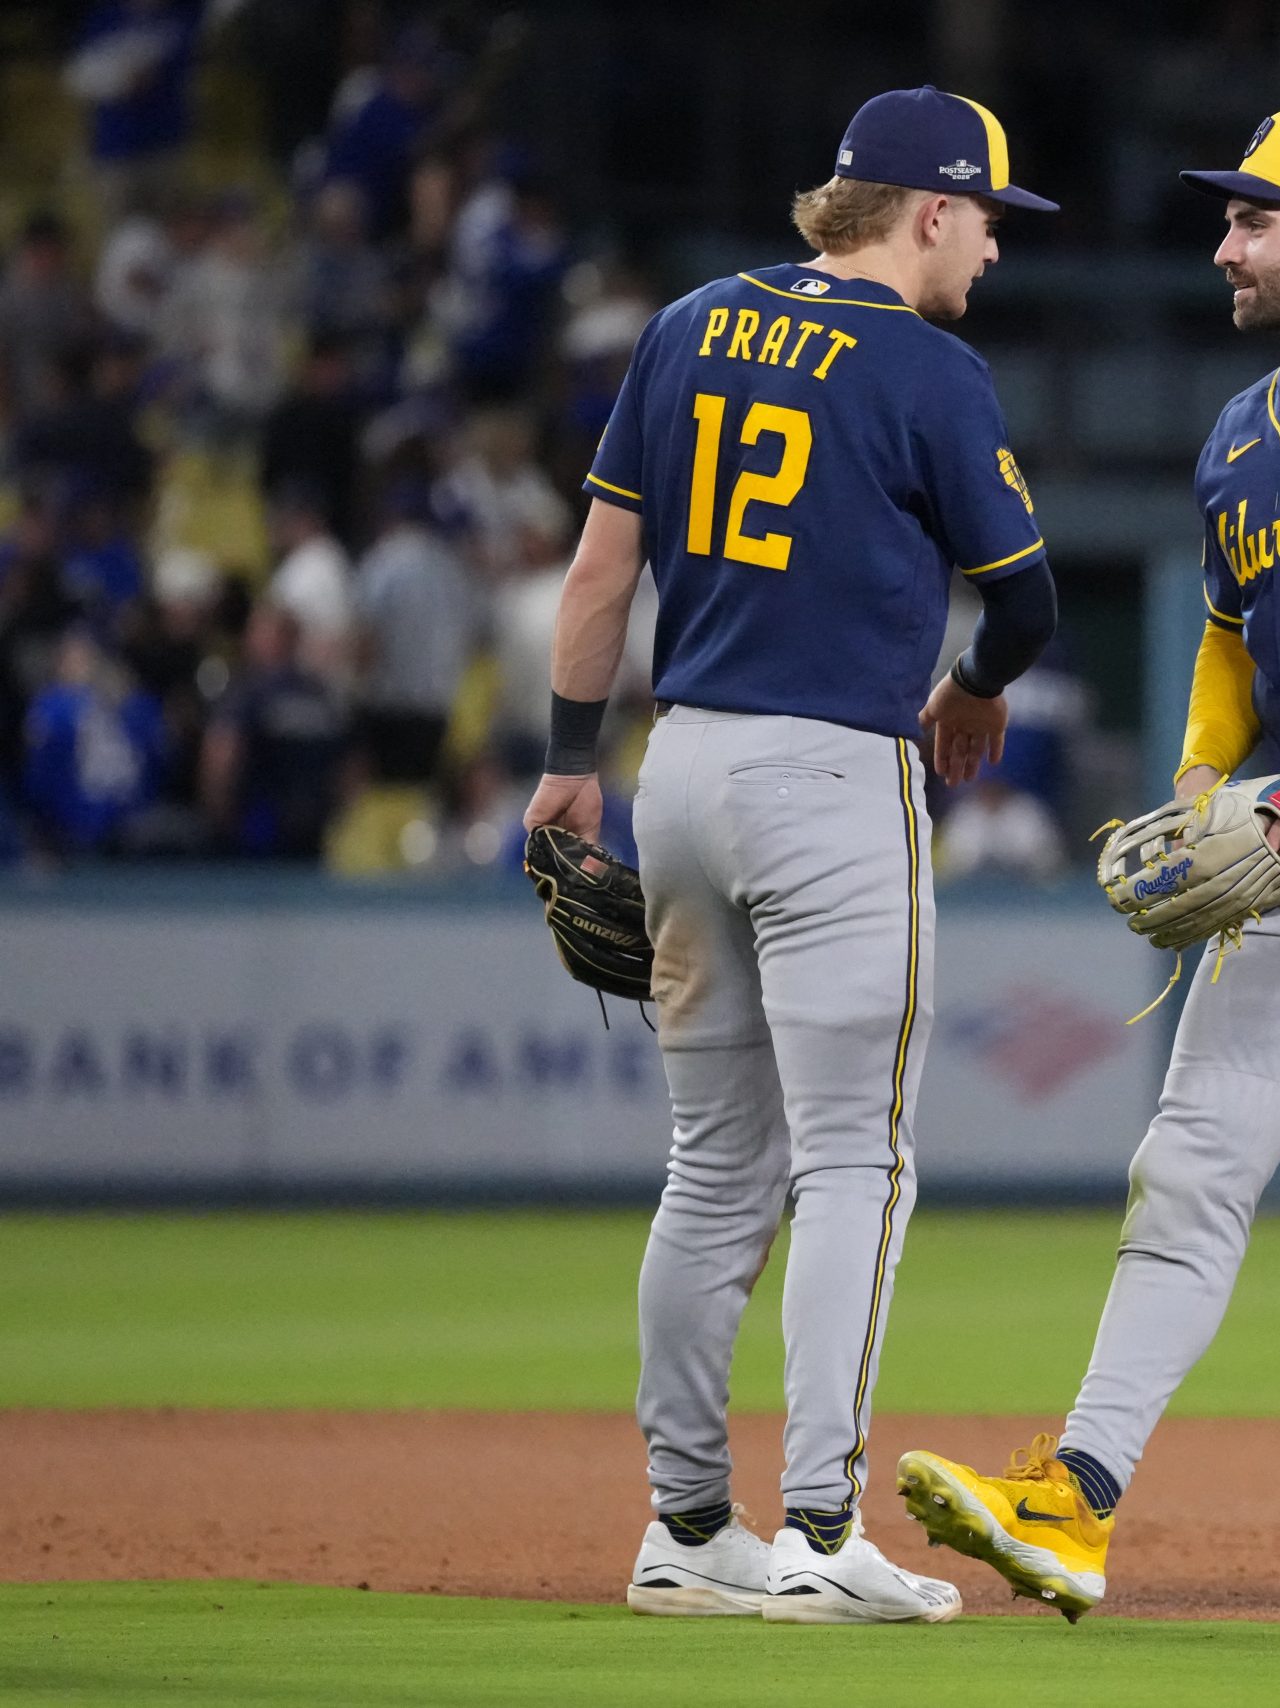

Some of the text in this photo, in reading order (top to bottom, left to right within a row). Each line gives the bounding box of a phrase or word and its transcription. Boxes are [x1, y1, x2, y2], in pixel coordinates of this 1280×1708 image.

[938, 166, 982, 174] POSTSEASON
[698, 307, 858, 381] PRATT
[686, 393, 813, 571] 12
[1134, 857, 1194, 900] Rawlings
[286, 1022, 406, 1098] OF
[440, 1022, 654, 1098] AME
